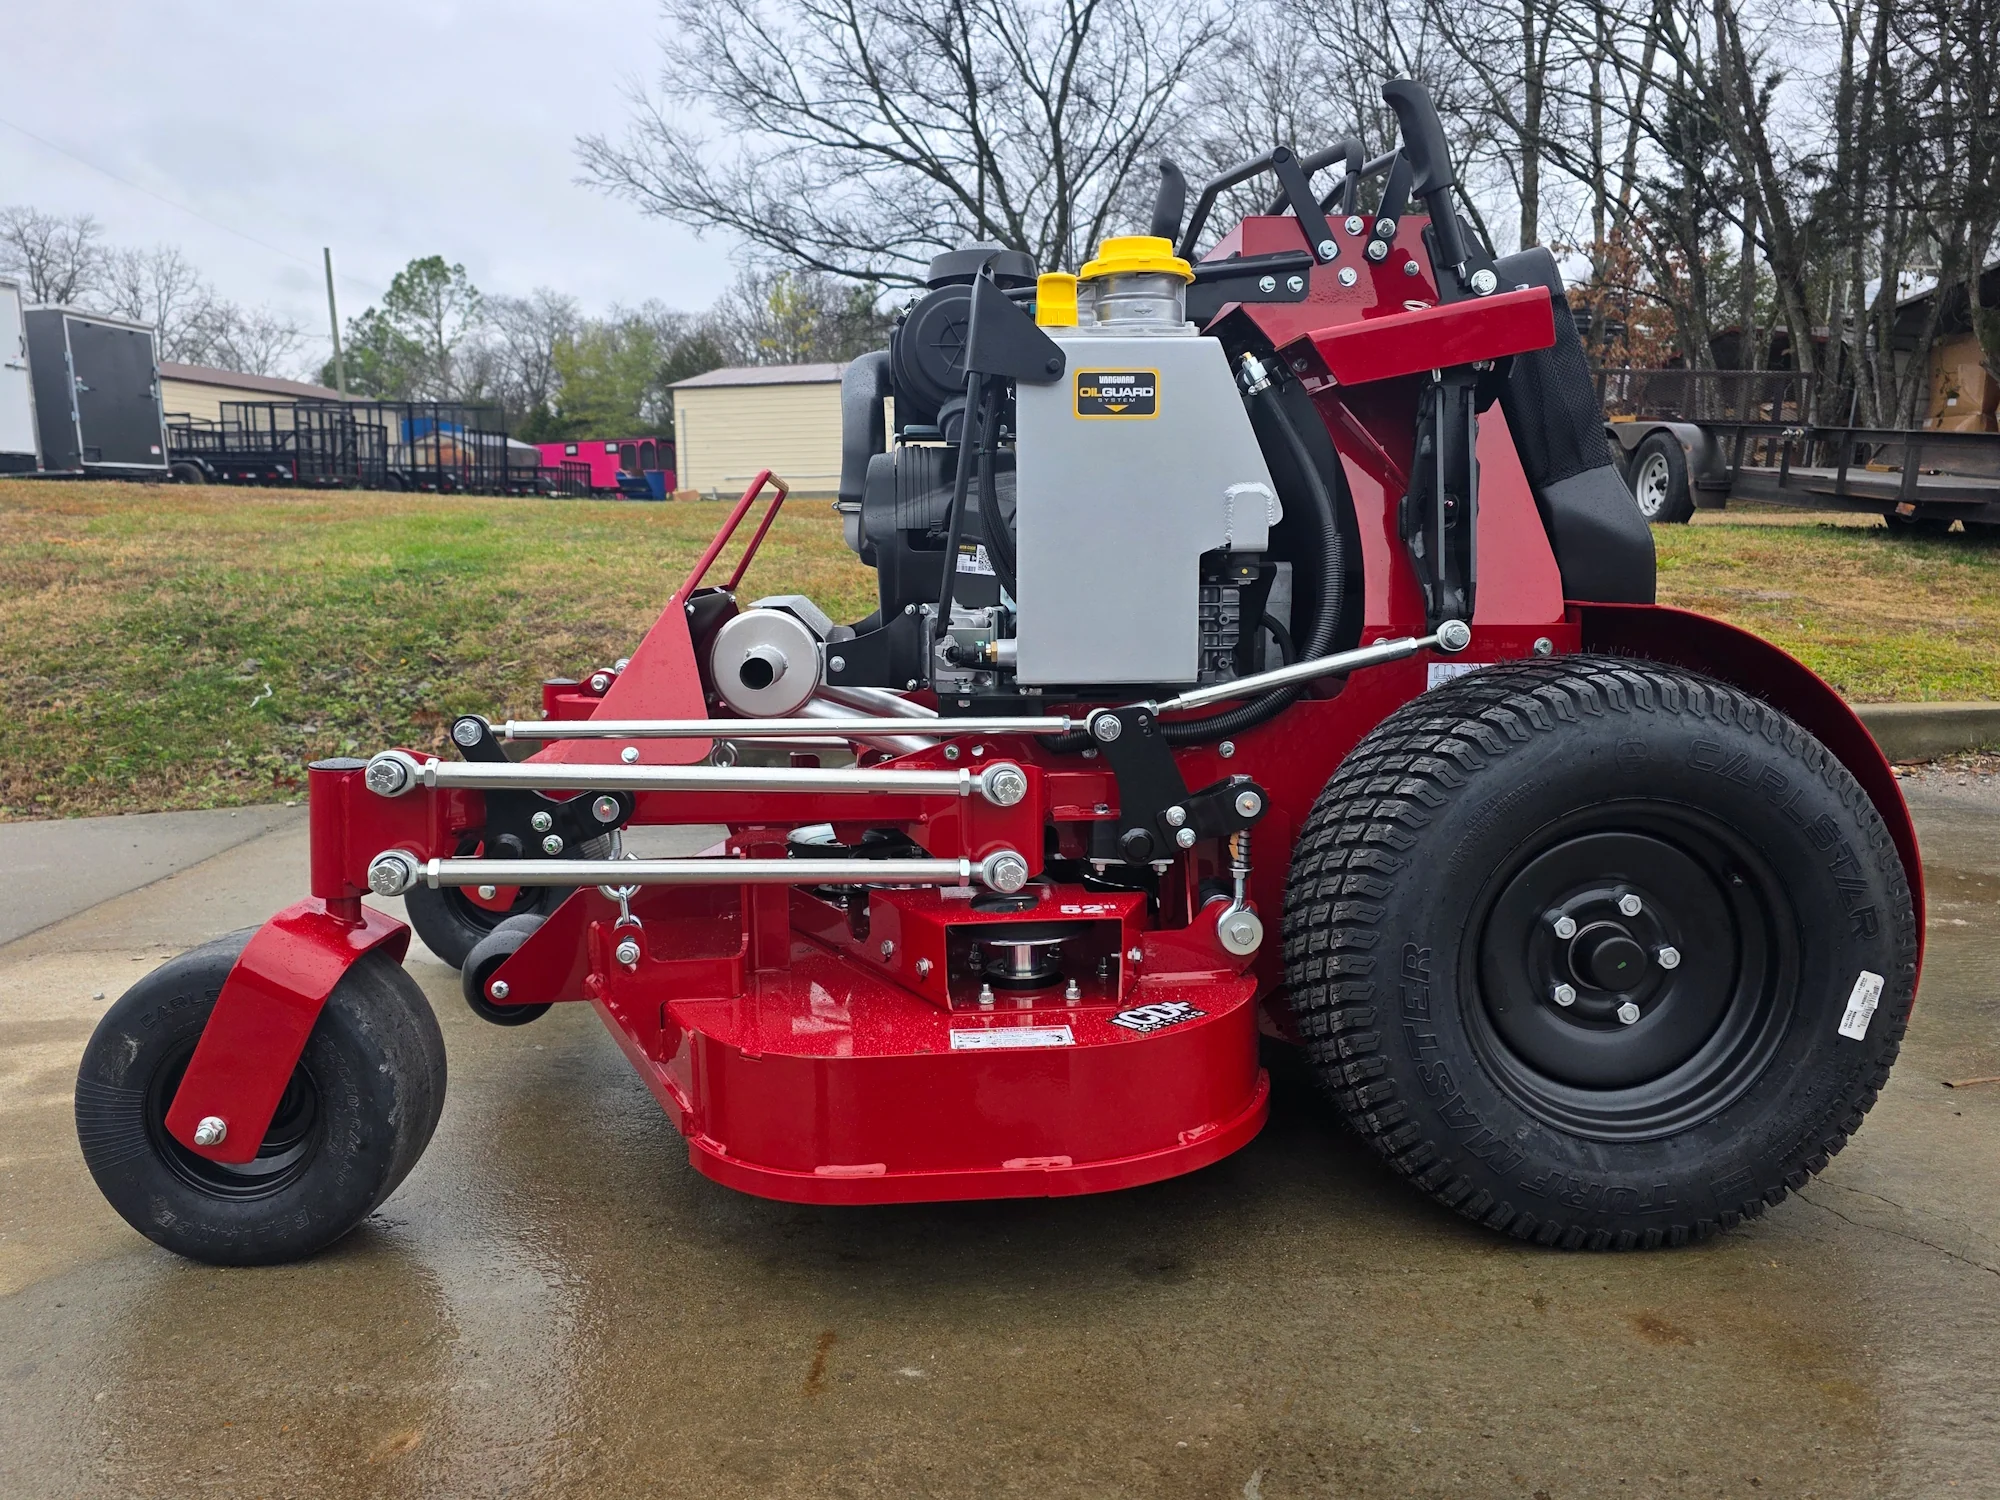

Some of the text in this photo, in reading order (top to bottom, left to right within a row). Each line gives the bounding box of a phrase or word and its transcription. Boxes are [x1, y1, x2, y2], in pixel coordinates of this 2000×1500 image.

[1099, 376, 1135, 384] VANGUARD
[1080, 387, 1154, 397] OILGUARD
[1463, 812, 1492, 842] RATING
[1688, 739, 1879, 940] CARLSTAR
[1060, 904, 1117, 914] 52"
[1400, 942, 1677, 1214] TURF MASTER
